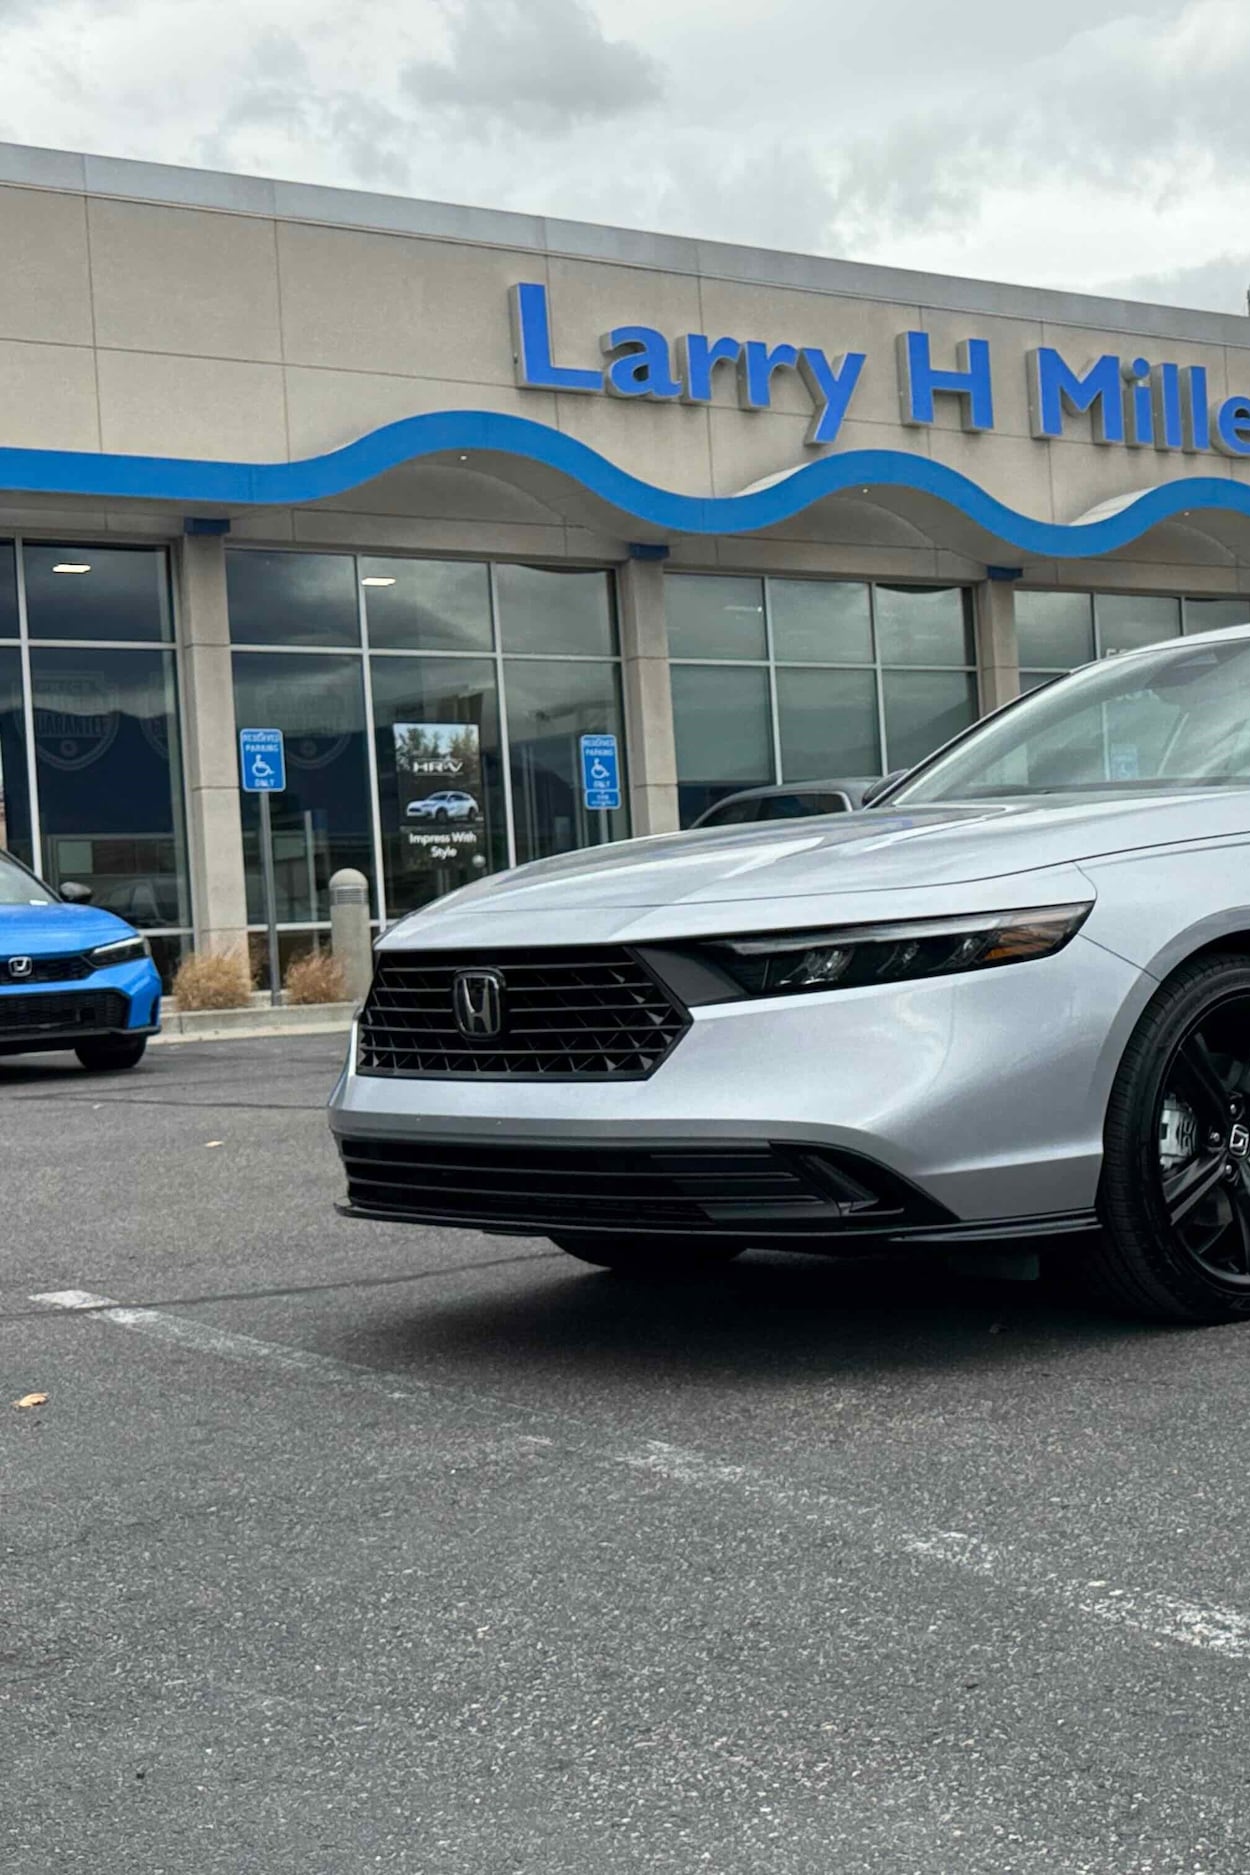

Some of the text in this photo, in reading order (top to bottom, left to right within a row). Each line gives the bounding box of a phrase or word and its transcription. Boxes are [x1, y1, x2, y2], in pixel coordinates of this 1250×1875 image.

[509, 283, 866, 446] Larry
[896, 328, 994, 434] H
[245, 744, 279, 752] PARKING
[409, 831, 478, 846] Impress With
[430, 845, 458, 859] Style
